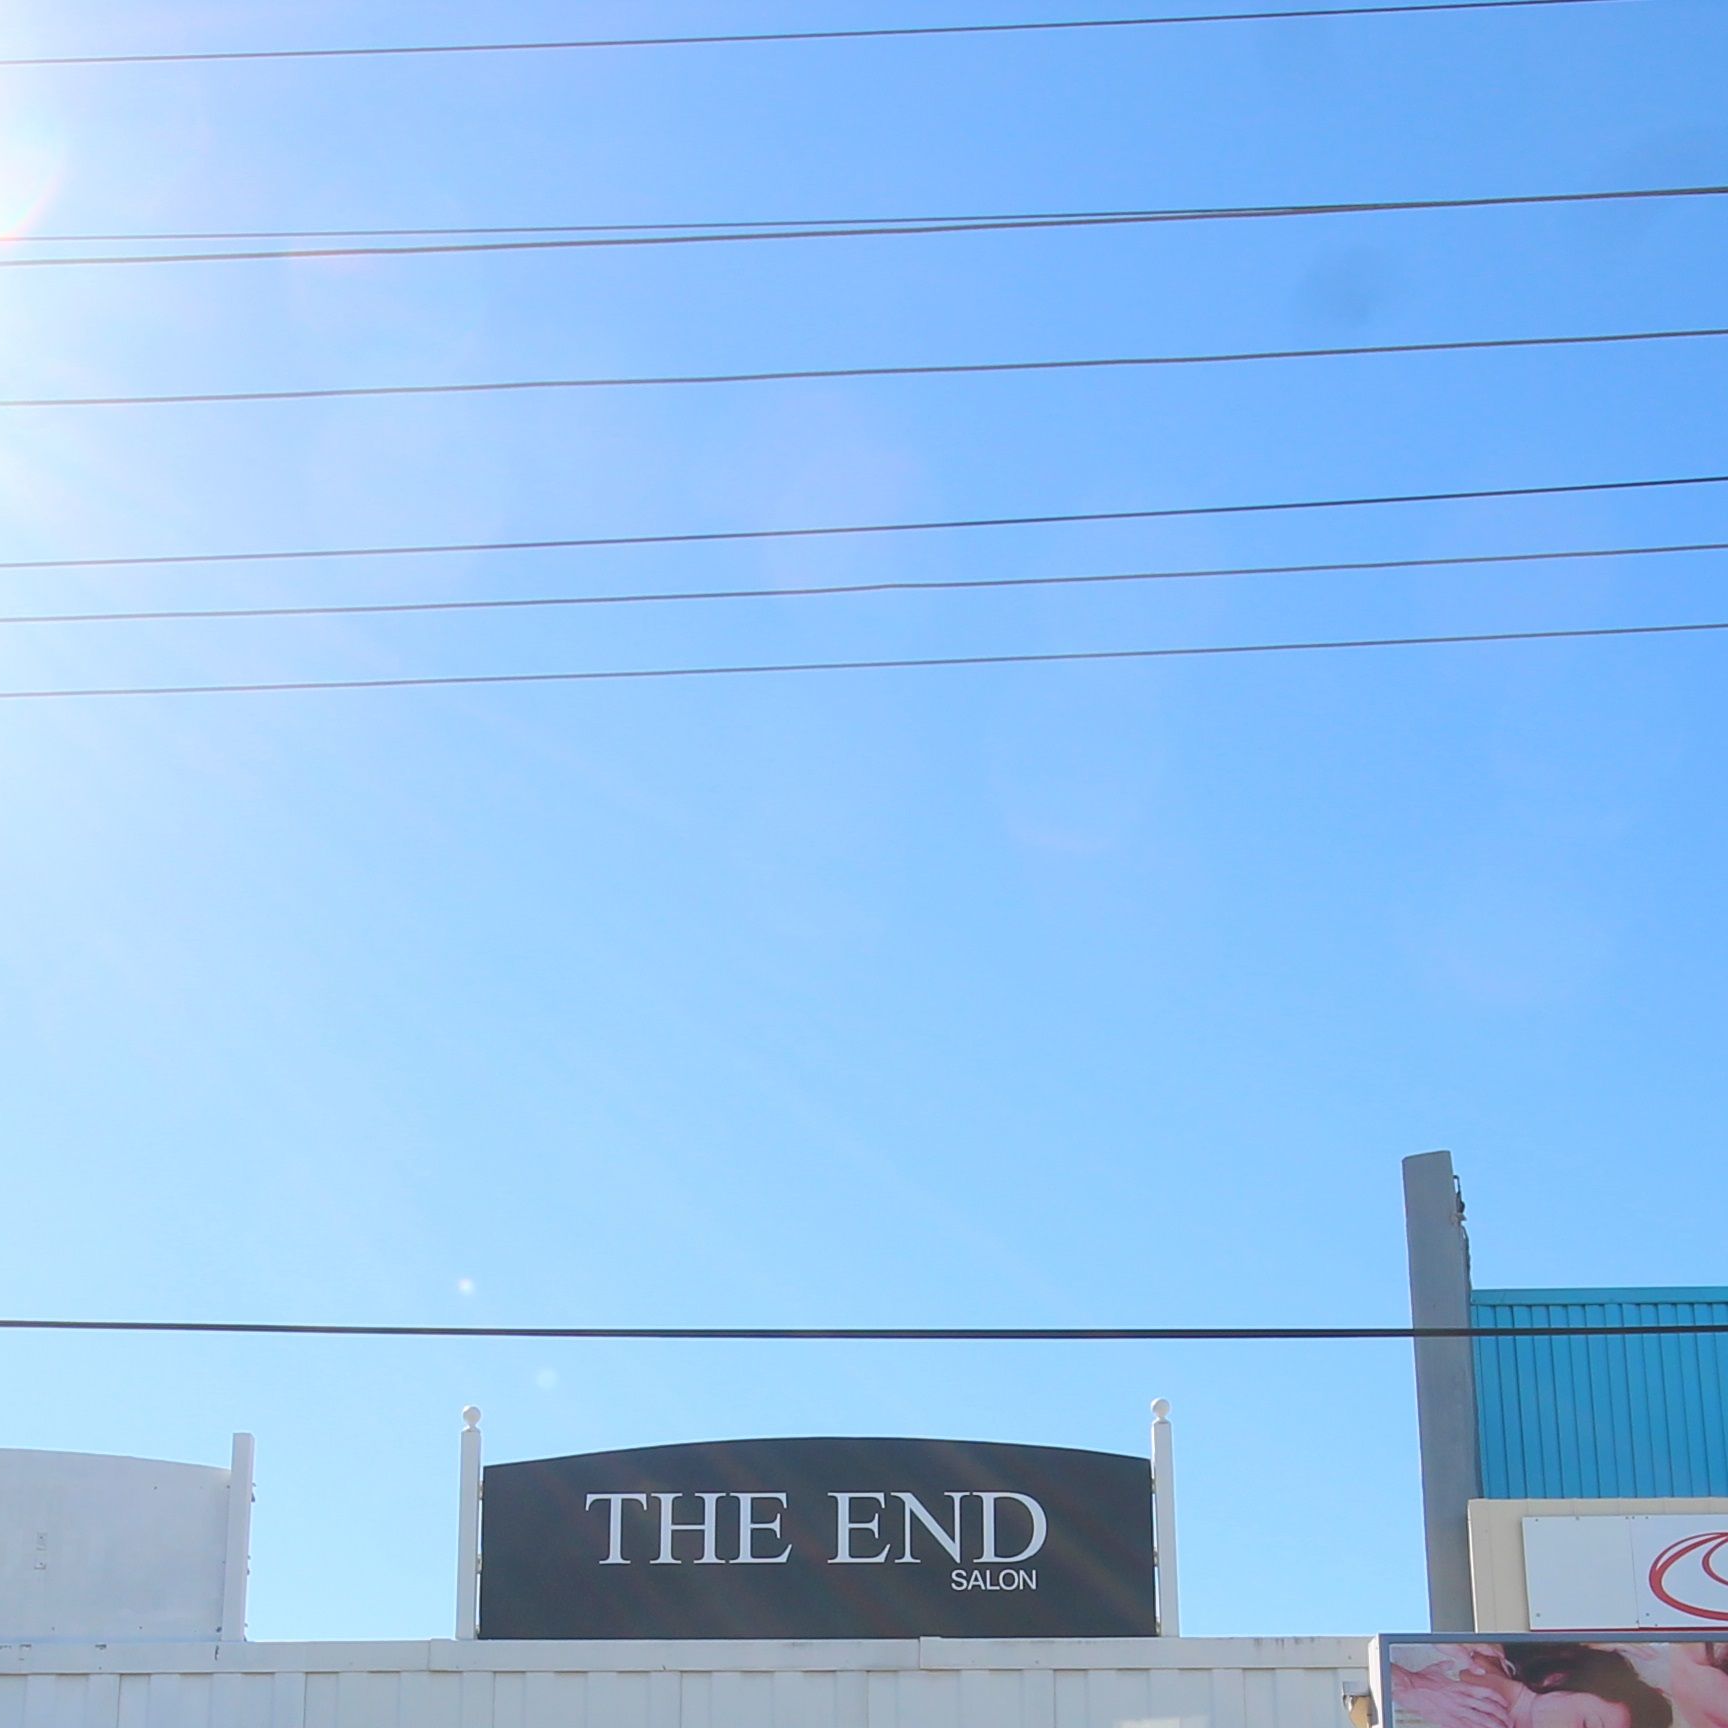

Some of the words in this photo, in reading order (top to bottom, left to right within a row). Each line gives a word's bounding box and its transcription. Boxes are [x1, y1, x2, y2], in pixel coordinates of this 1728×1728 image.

[585, 1492, 793, 1565] THE
[827, 1491, 1047, 1564] END
[951, 1569, 1037, 1591] SALON
